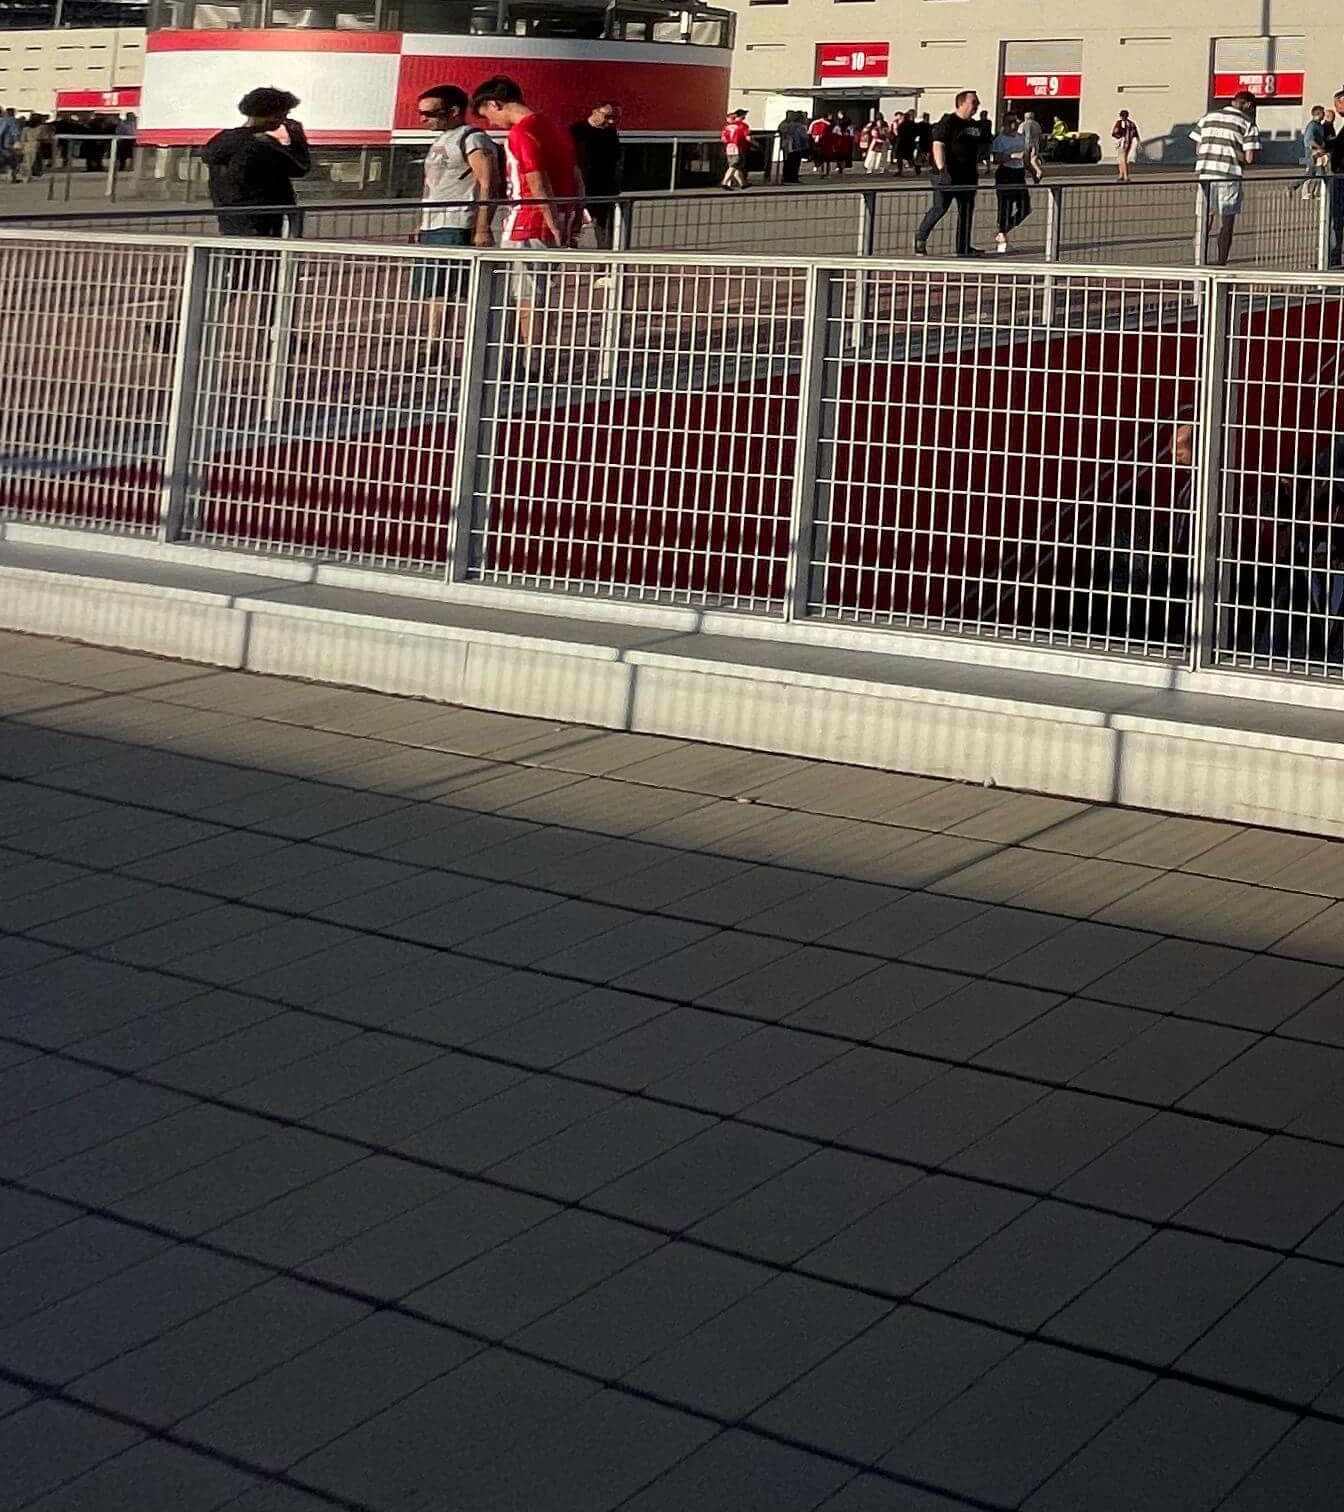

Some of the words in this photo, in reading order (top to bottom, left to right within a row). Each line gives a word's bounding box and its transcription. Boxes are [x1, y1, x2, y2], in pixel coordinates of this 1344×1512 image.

[851, 51, 865, 71] 10
[1049, 76, 1059, 96] 9
[1265, 75, 1275, 94] 8
